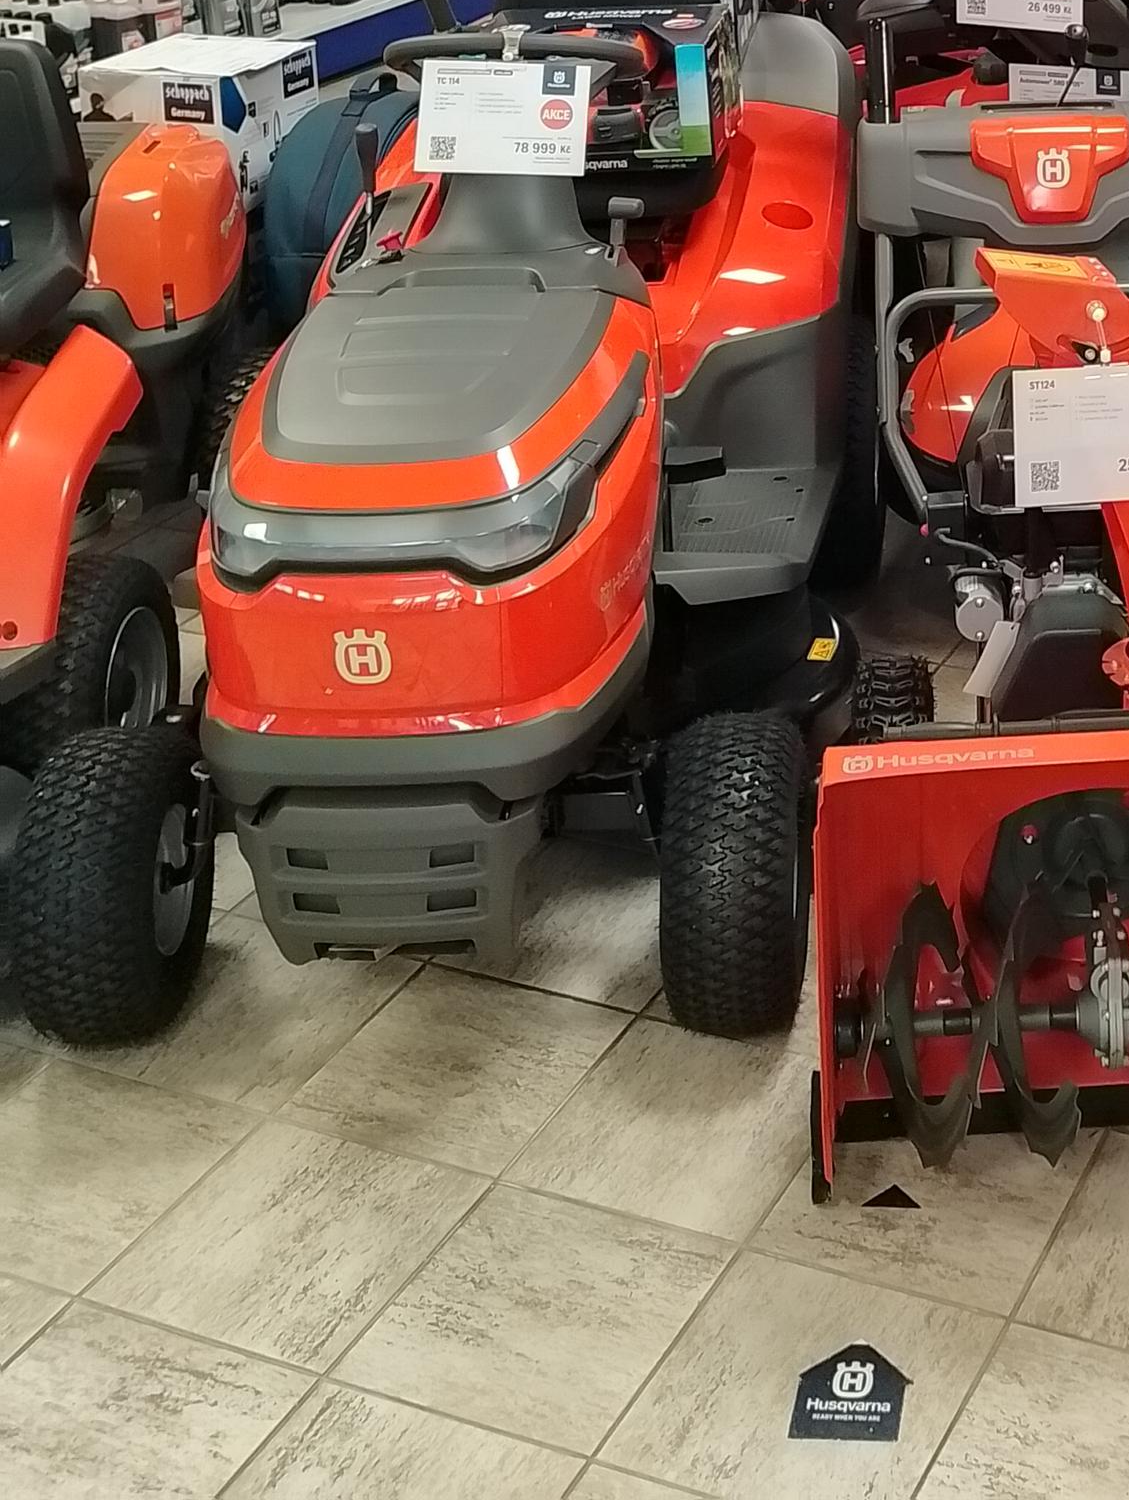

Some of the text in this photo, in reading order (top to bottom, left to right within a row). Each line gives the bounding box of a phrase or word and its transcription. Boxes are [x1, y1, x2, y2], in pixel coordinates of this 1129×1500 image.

[1027, 1, 1040, 12] 26
[1041, 2, 1061, 14] 499
[287, 77, 310, 92] Germany
[436, 77, 460, 85] TC 114
[165, 81, 210, 105] scheppach
[170, 107, 206, 121] Germany
[542, 109, 571, 121] AKCE
[513, 142, 529, 154] 78
[532, 142, 556, 155] 999
[585, 157, 628, 171] sqvarna
[1029, 380, 1056, 390] ST124
[876, 747, 1035, 769] Husqvarna
[806, 1397, 891, 1413] Husqvarna
[812, 1413, 881, 1422] READY WHEN YOU ARE
